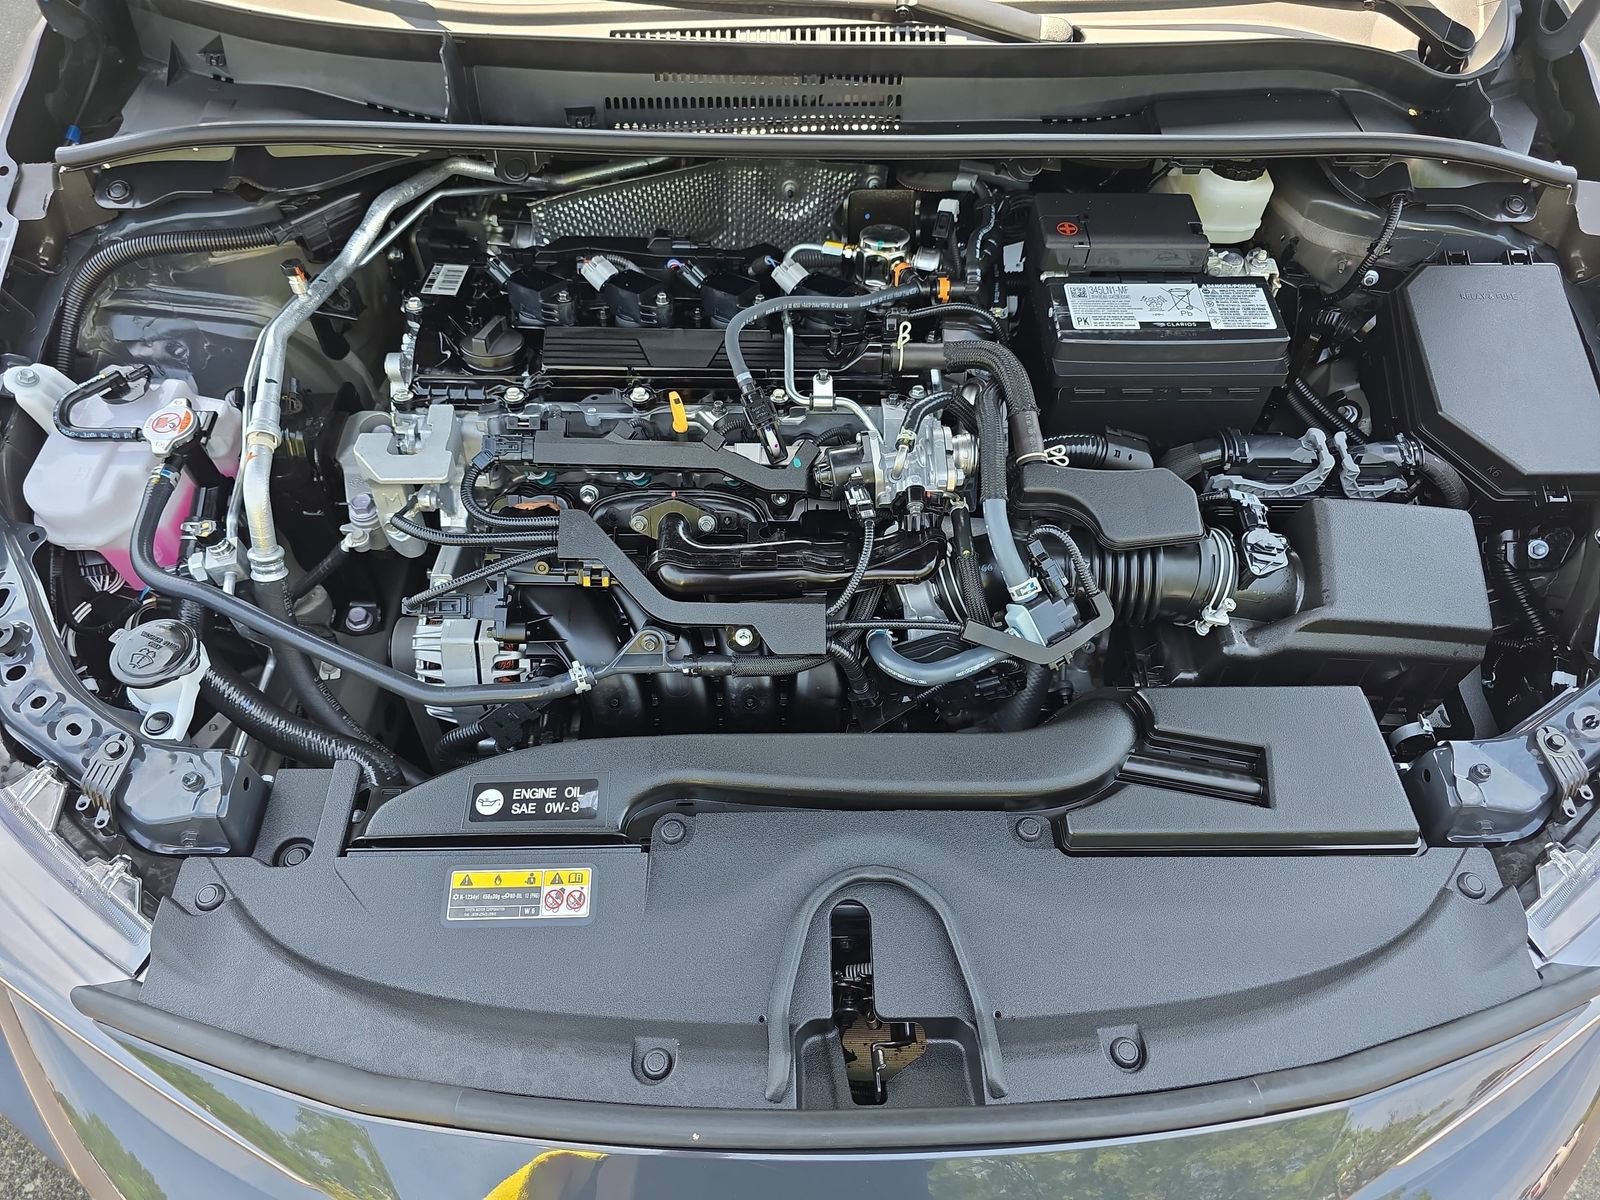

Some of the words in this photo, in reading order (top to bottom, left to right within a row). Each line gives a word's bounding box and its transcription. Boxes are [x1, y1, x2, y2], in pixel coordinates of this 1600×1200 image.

[1076, 317, 1089, 326] PK
[512, 787, 557, 800] ENGINE
[564, 786, 584, 798] OIL
[511, 803, 537, 814] SAE
[544, 802, 580, 814] 0W-8
